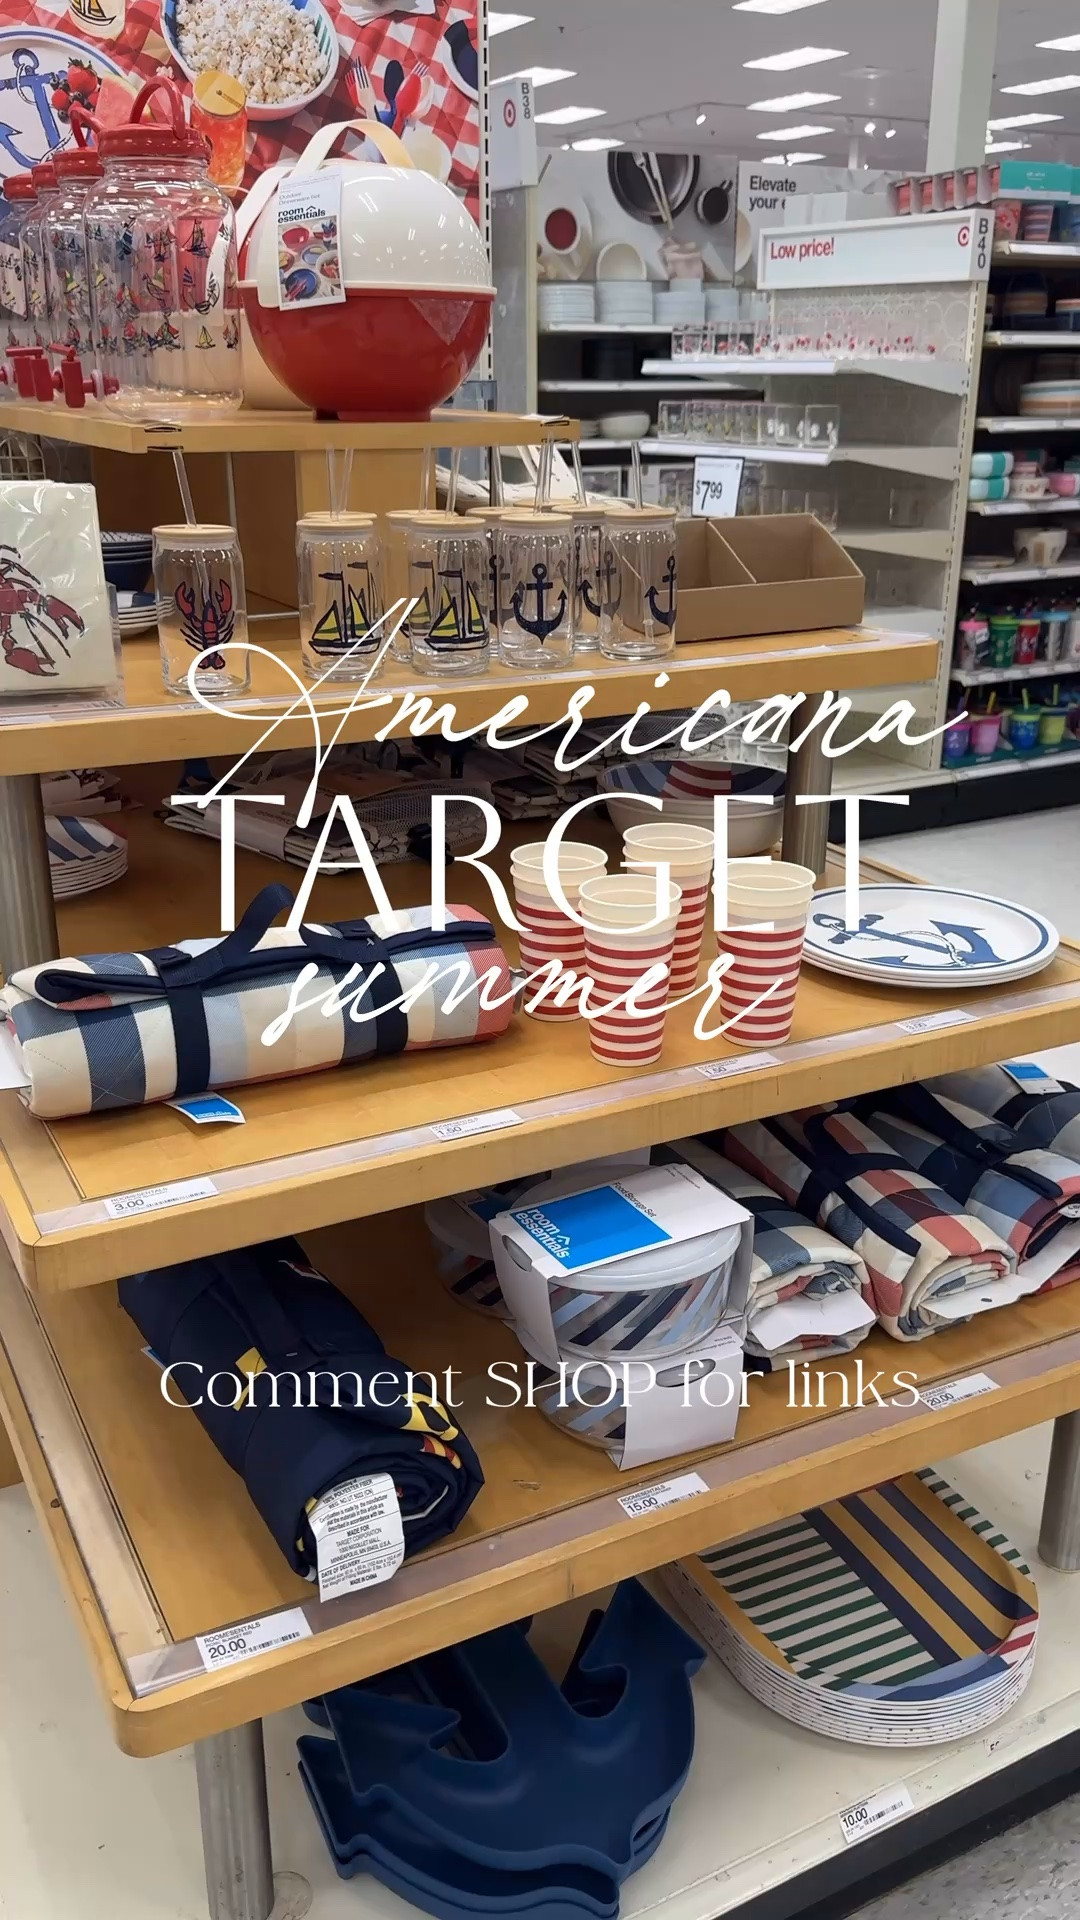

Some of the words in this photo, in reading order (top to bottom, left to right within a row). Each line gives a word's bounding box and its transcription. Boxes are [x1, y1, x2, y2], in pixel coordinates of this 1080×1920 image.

[521, 82, 531, 119] B38
[750, 175, 797, 192] Elevate
[278, 207, 304, 217] room
[749, 196, 779, 212] your
[278, 208, 326, 223] essentials
[771, 242, 796, 260] Low
[799, 237, 834, 263] price!
[977, 218, 989, 269] B40
[115, 1199, 145, 1211] 3.00
[613, 1182, 627, 1197] Food
[624, 1192, 646, 1213] Storage
[645, 1208, 657, 1217] Set
[527, 1208, 561, 1237] room
[515, 1212, 570, 1259] essentials
[927, 1392, 954, 1407] 20.00
[627, 1497, 658, 1513] 15.00
[336, 1537, 352, 1547] TARGET
[352, 1527, 382, 1542] CORPORATION
[347, 1527, 360, 1537] MADE
[360, 1524, 370, 1532] FOR
[321, 1569, 332, 1578] DATE
[333, 1566, 339, 1574] OF
[339, 1559, 360, 1571] DELIVERY
[350, 1577, 361, 1586] MADE
[366, 1572, 378, 1580] CHINA
[204, 1621, 261, 1644] ROOMESENTALS
[208, 1638, 247, 1660] 20.00
[842, 1807, 868, 1828] 10.00
